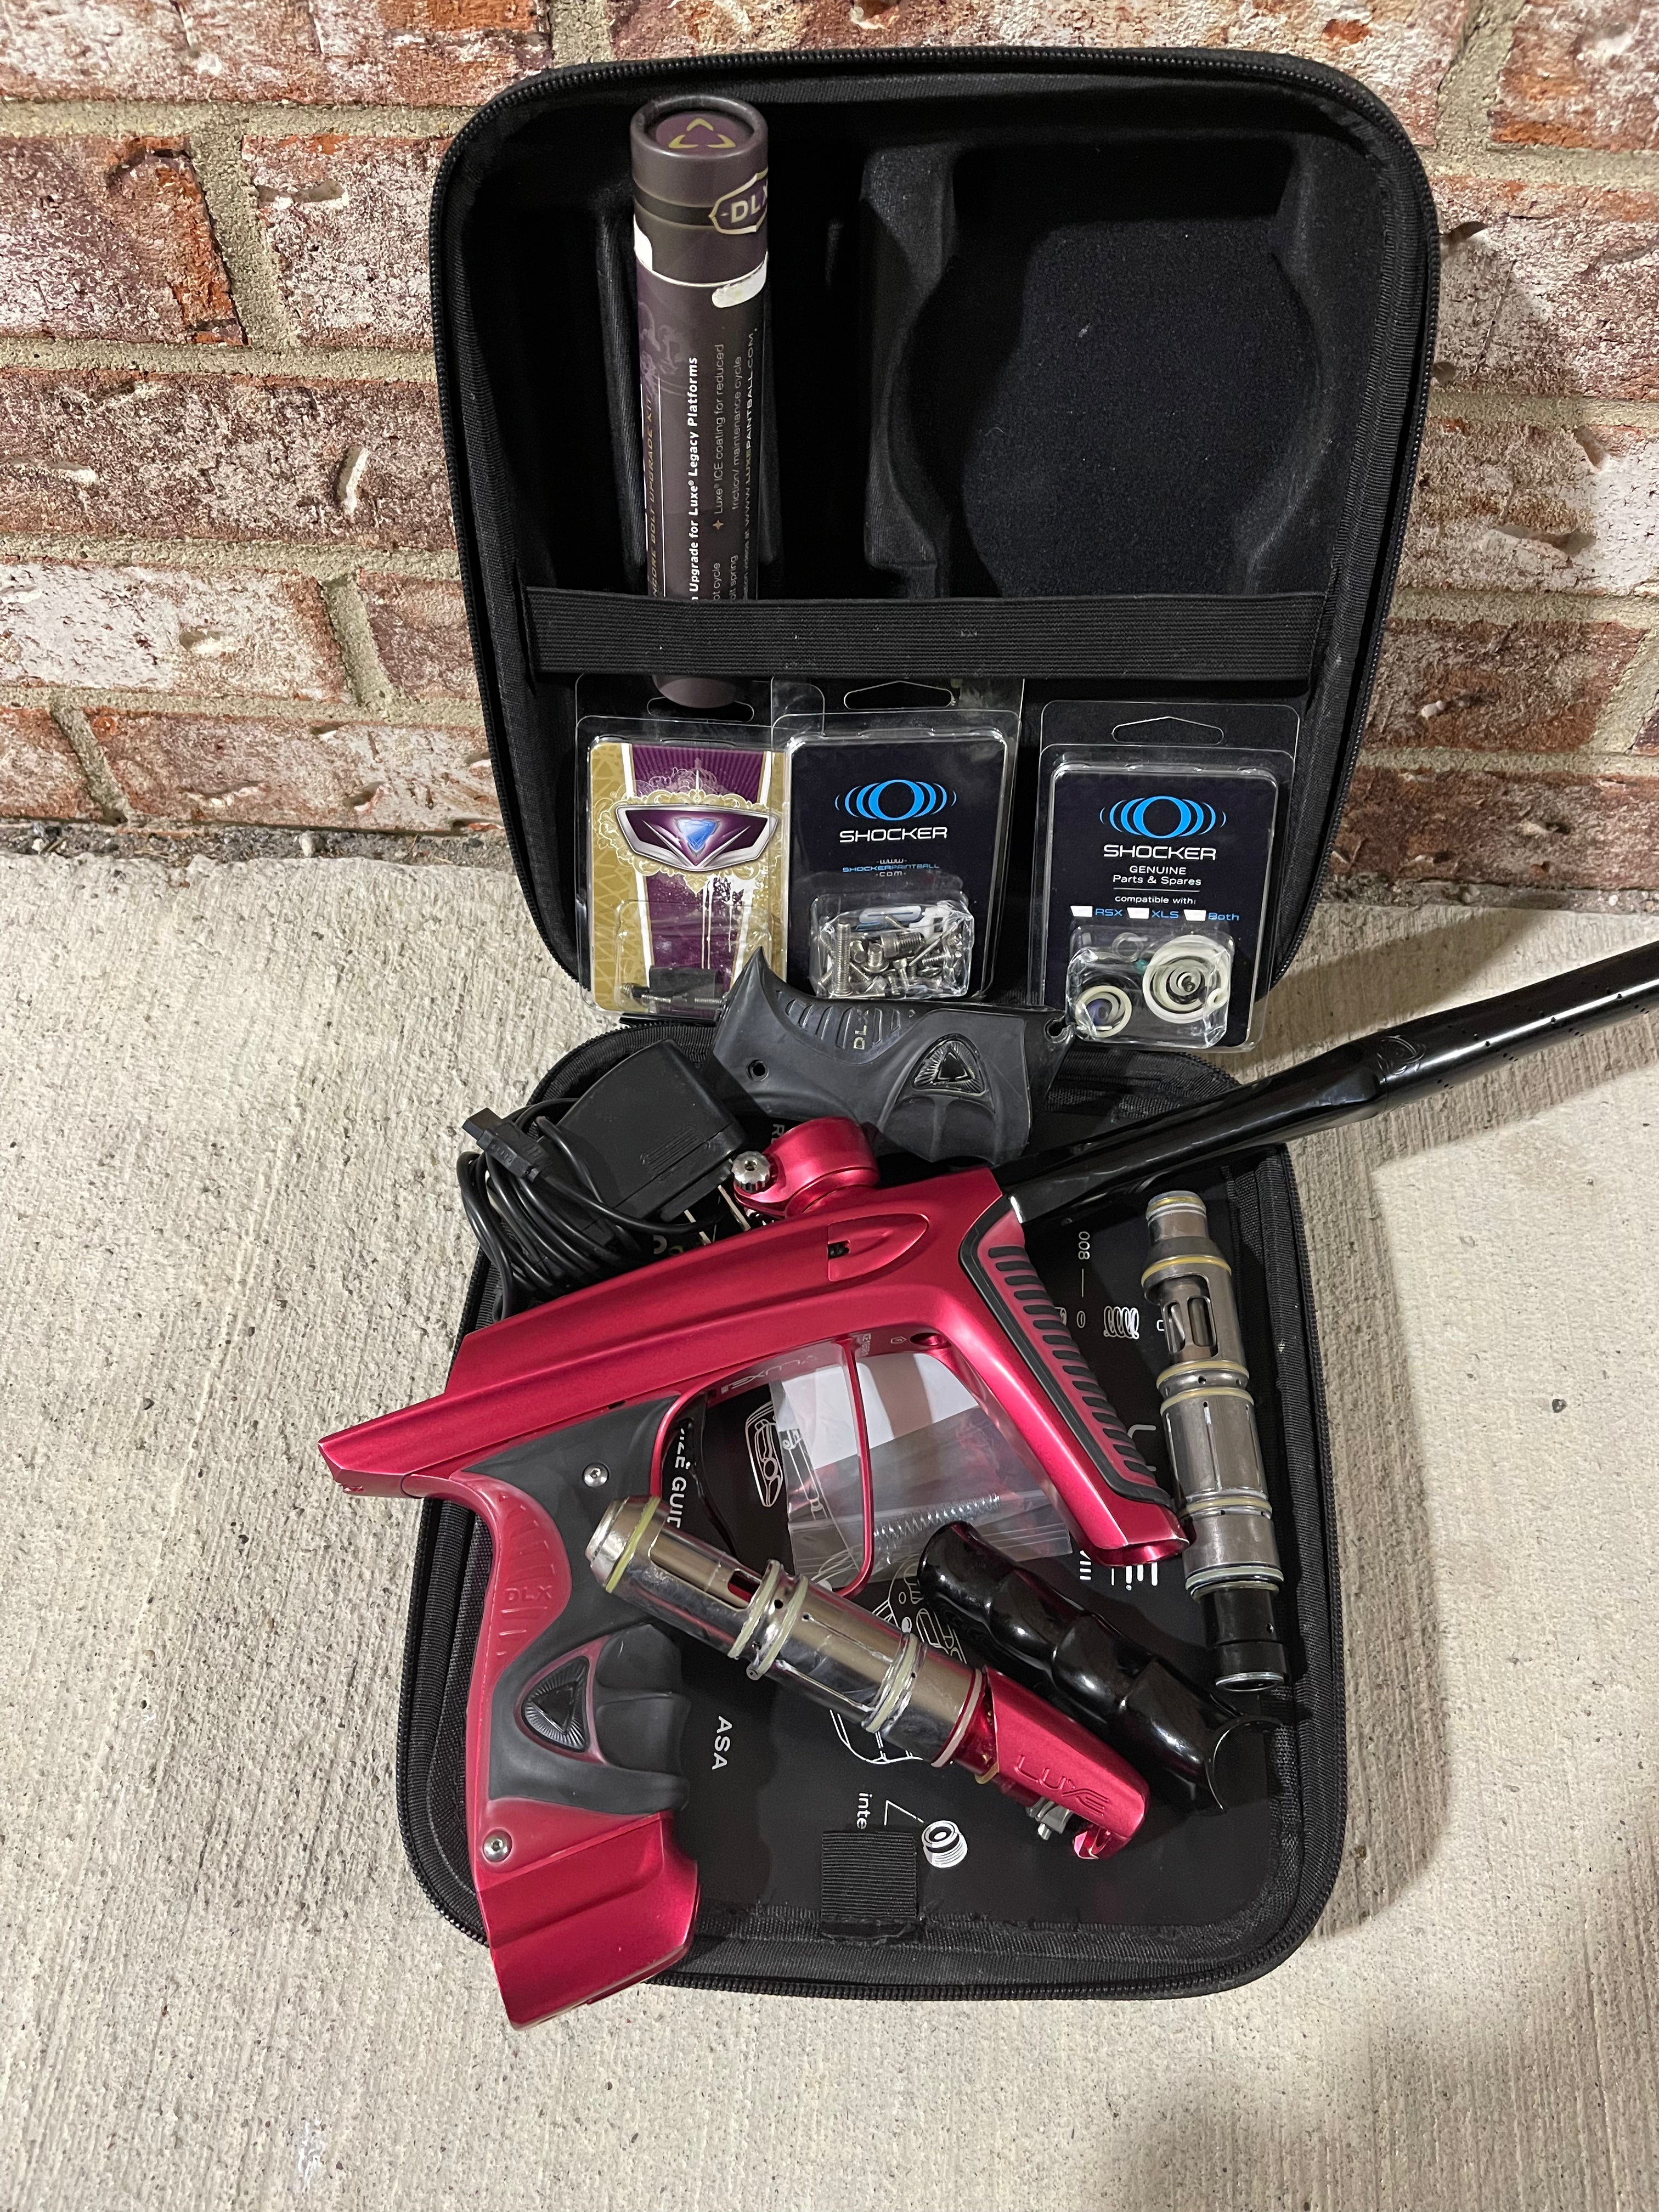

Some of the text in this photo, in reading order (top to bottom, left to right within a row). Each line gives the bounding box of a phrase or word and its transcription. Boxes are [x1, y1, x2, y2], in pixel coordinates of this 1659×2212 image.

[713, 344, 724, 398] reduced
[732, 356, 743, 388] cycle
[687, 357, 698, 427] Platforms
[714, 399, 724, 415] for
[714, 417, 725, 460] coating
[731, 391, 741, 466] maintenance
[687, 431, 699, 476] Legacy
[714, 462, 724, 482] ICE
[689, 521, 698, 538] for
[689, 542, 700, 592] Upgrade
[712, 562, 722, 589] cycle
[729, 554, 738, 586] spring
[839, 826, 948, 844] SHOCKER
[1103, 844, 1217, 861] SHOCKER
[1113, 874, 1202, 887] Parts & Spares
[1129, 865, 1187, 876] GENUINE
[1115, 895, 1169, 905] compatible
[1094, 908, 1240, 922] RSX XLS Both
[1078, 1231, 1091, 1260] 008
[712, 1716, 733, 1770] ASA
[1014, 1754, 1111, 1817] LUXE
